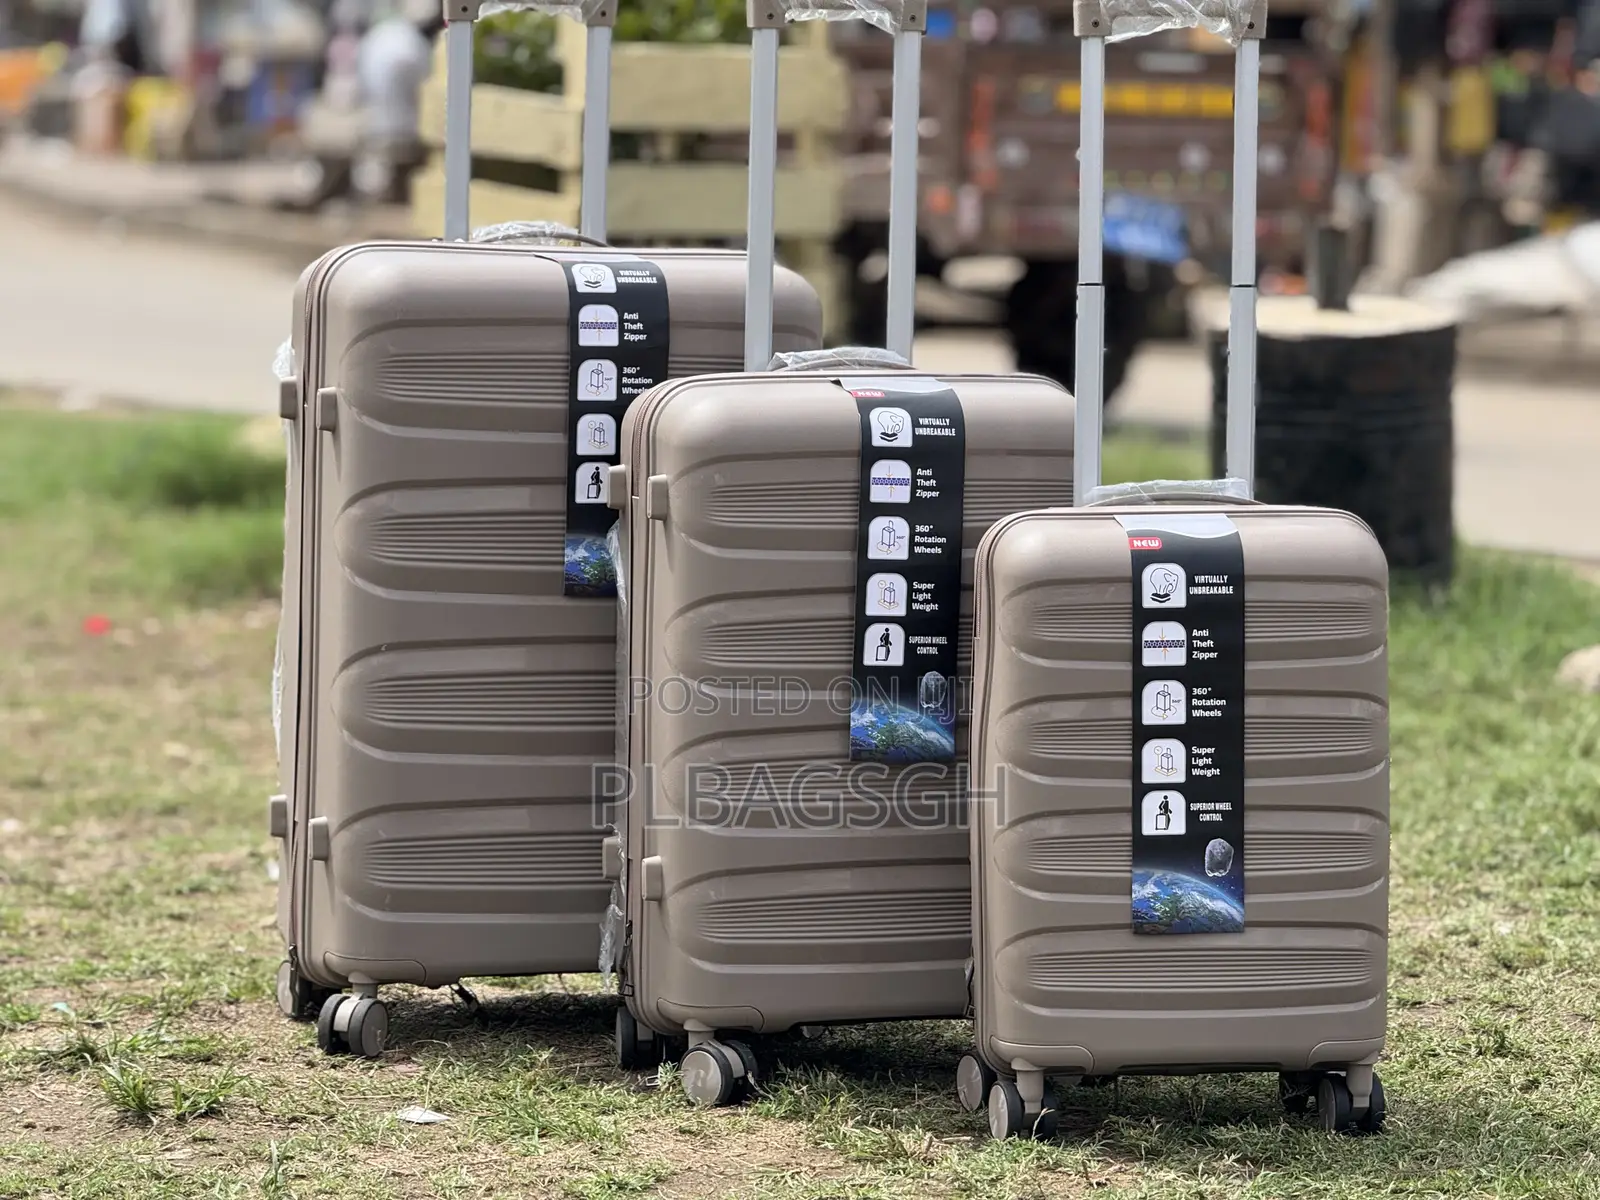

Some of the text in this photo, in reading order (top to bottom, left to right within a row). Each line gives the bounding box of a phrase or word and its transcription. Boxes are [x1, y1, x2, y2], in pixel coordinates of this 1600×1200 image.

[624, 332, 648, 342] Zipper
[918, 418, 950, 426] VIRTUALLY
[915, 428, 956, 436] UNBREAKABLE
[916, 468, 932, 476] Anti
[916, 478, 936, 486] Theft
[916, 490, 940, 498] Zipper
[1132, 539, 1160, 547] NEW
[1194, 575, 1228, 584] VIRTUALLY
[912, 582, 935, 590] Super
[1189, 586, 1234, 594] UNBREAKABLE
[912, 592, 932, 602] Light
[912, 602, 938, 612] Weight
[1192, 628, 1209, 636] Anti
[908, 636, 948, 644] SUPERIOR WHEEL
[1192, 640, 1214, 648] Theft
[916, 646, 938, 654] CONTROL
[1192, 650, 1218, 660] Zipper
[1192, 698, 1226, 706] Rotation
[1192, 709, 1222, 717] Wheels
[1192, 746, 1216, 756] Super
[1192, 757, 1212, 767] Light
[1192, 768, 1220, 778] Weight
[1190, 802, 1232, 811] SUPERIOR WHEEL
[1199, 812, 1223, 822] CONTROL
